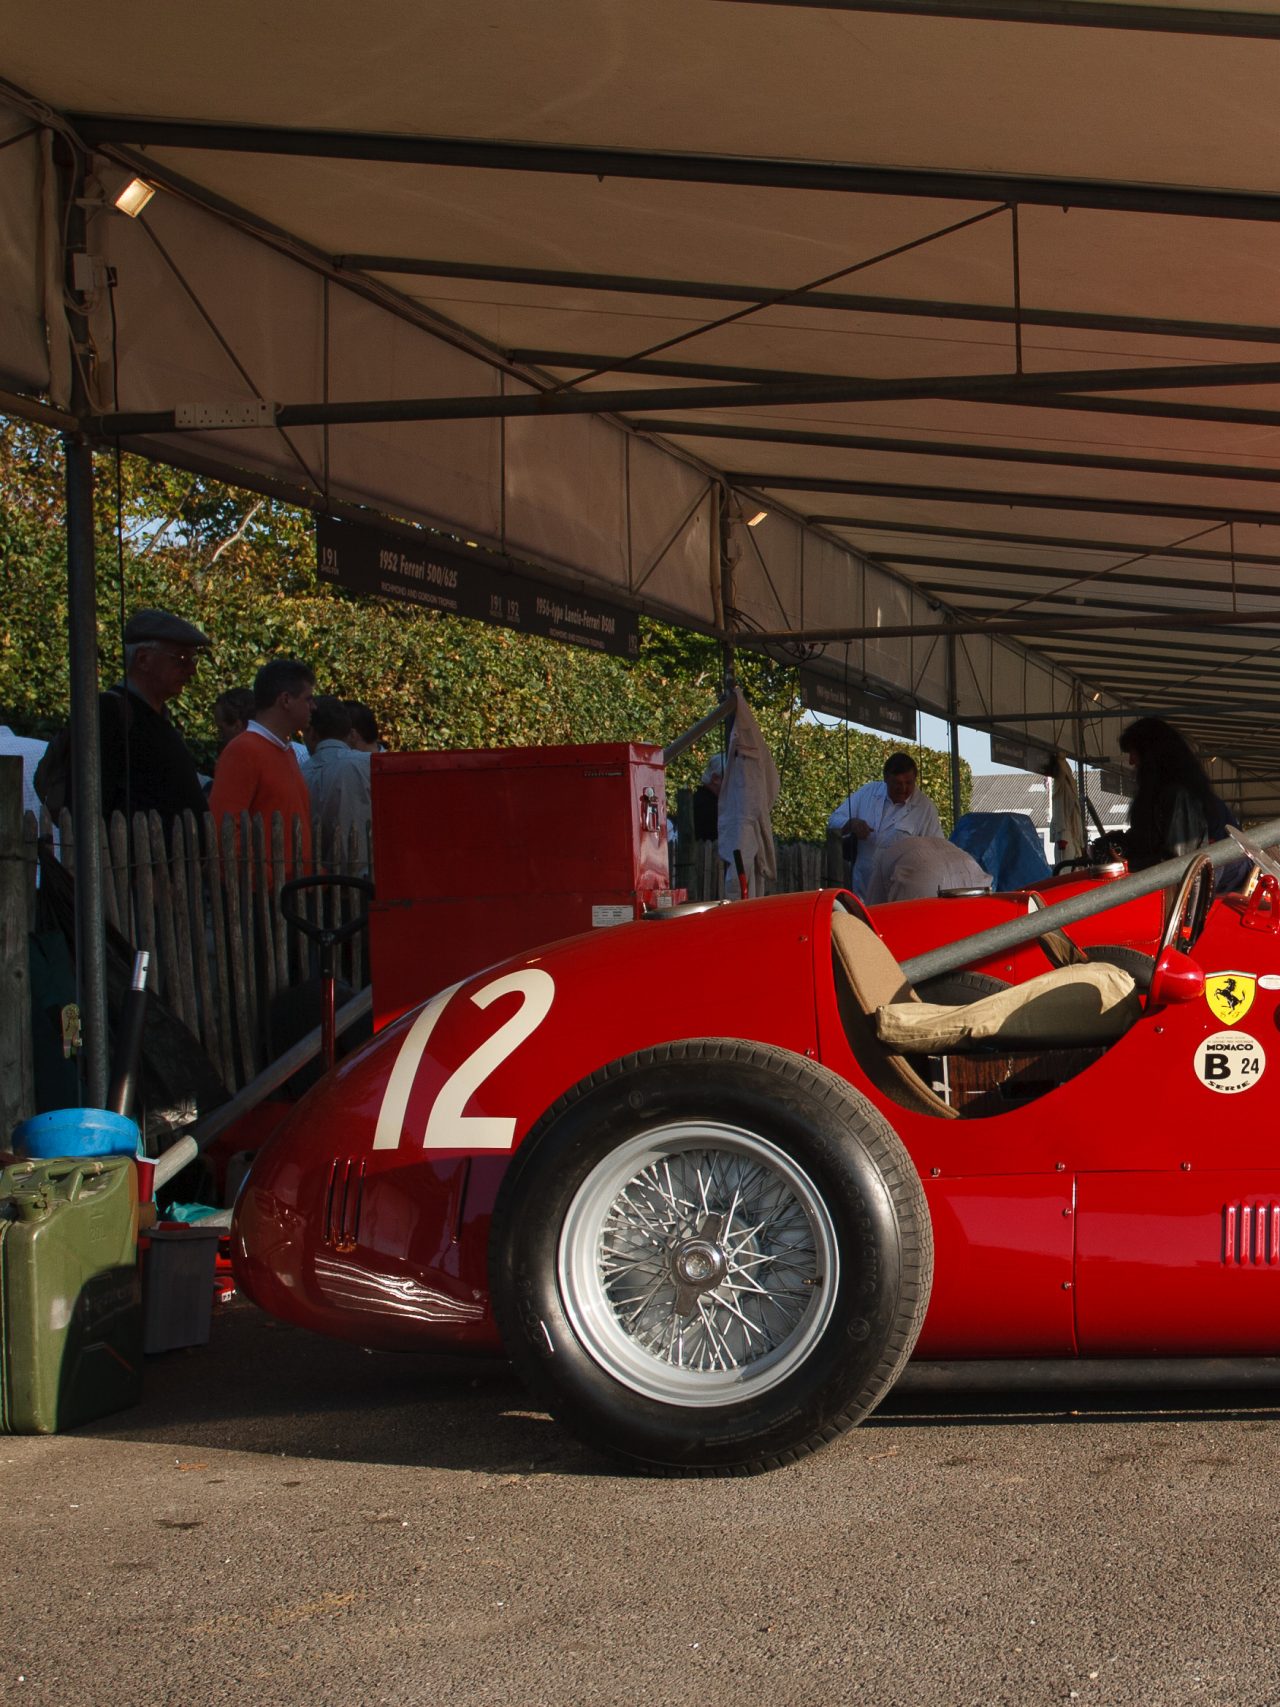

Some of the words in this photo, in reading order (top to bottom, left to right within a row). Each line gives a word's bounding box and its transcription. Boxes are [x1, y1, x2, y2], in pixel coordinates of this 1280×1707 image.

[322, 546, 338, 568] 191
[379, 549, 398, 572] 1952
[400, 554, 425, 580] Ferrari
[426, 563, 458, 588] 500/625
[372, 968, 555, 1150] 12
[1206, 1043, 1254, 1051] MONACO
[1204, 1053, 1231, 1080] B
[1241, 1058, 1260, 1074] 24
[1208, 1080, 1251, 1091] SERIE
